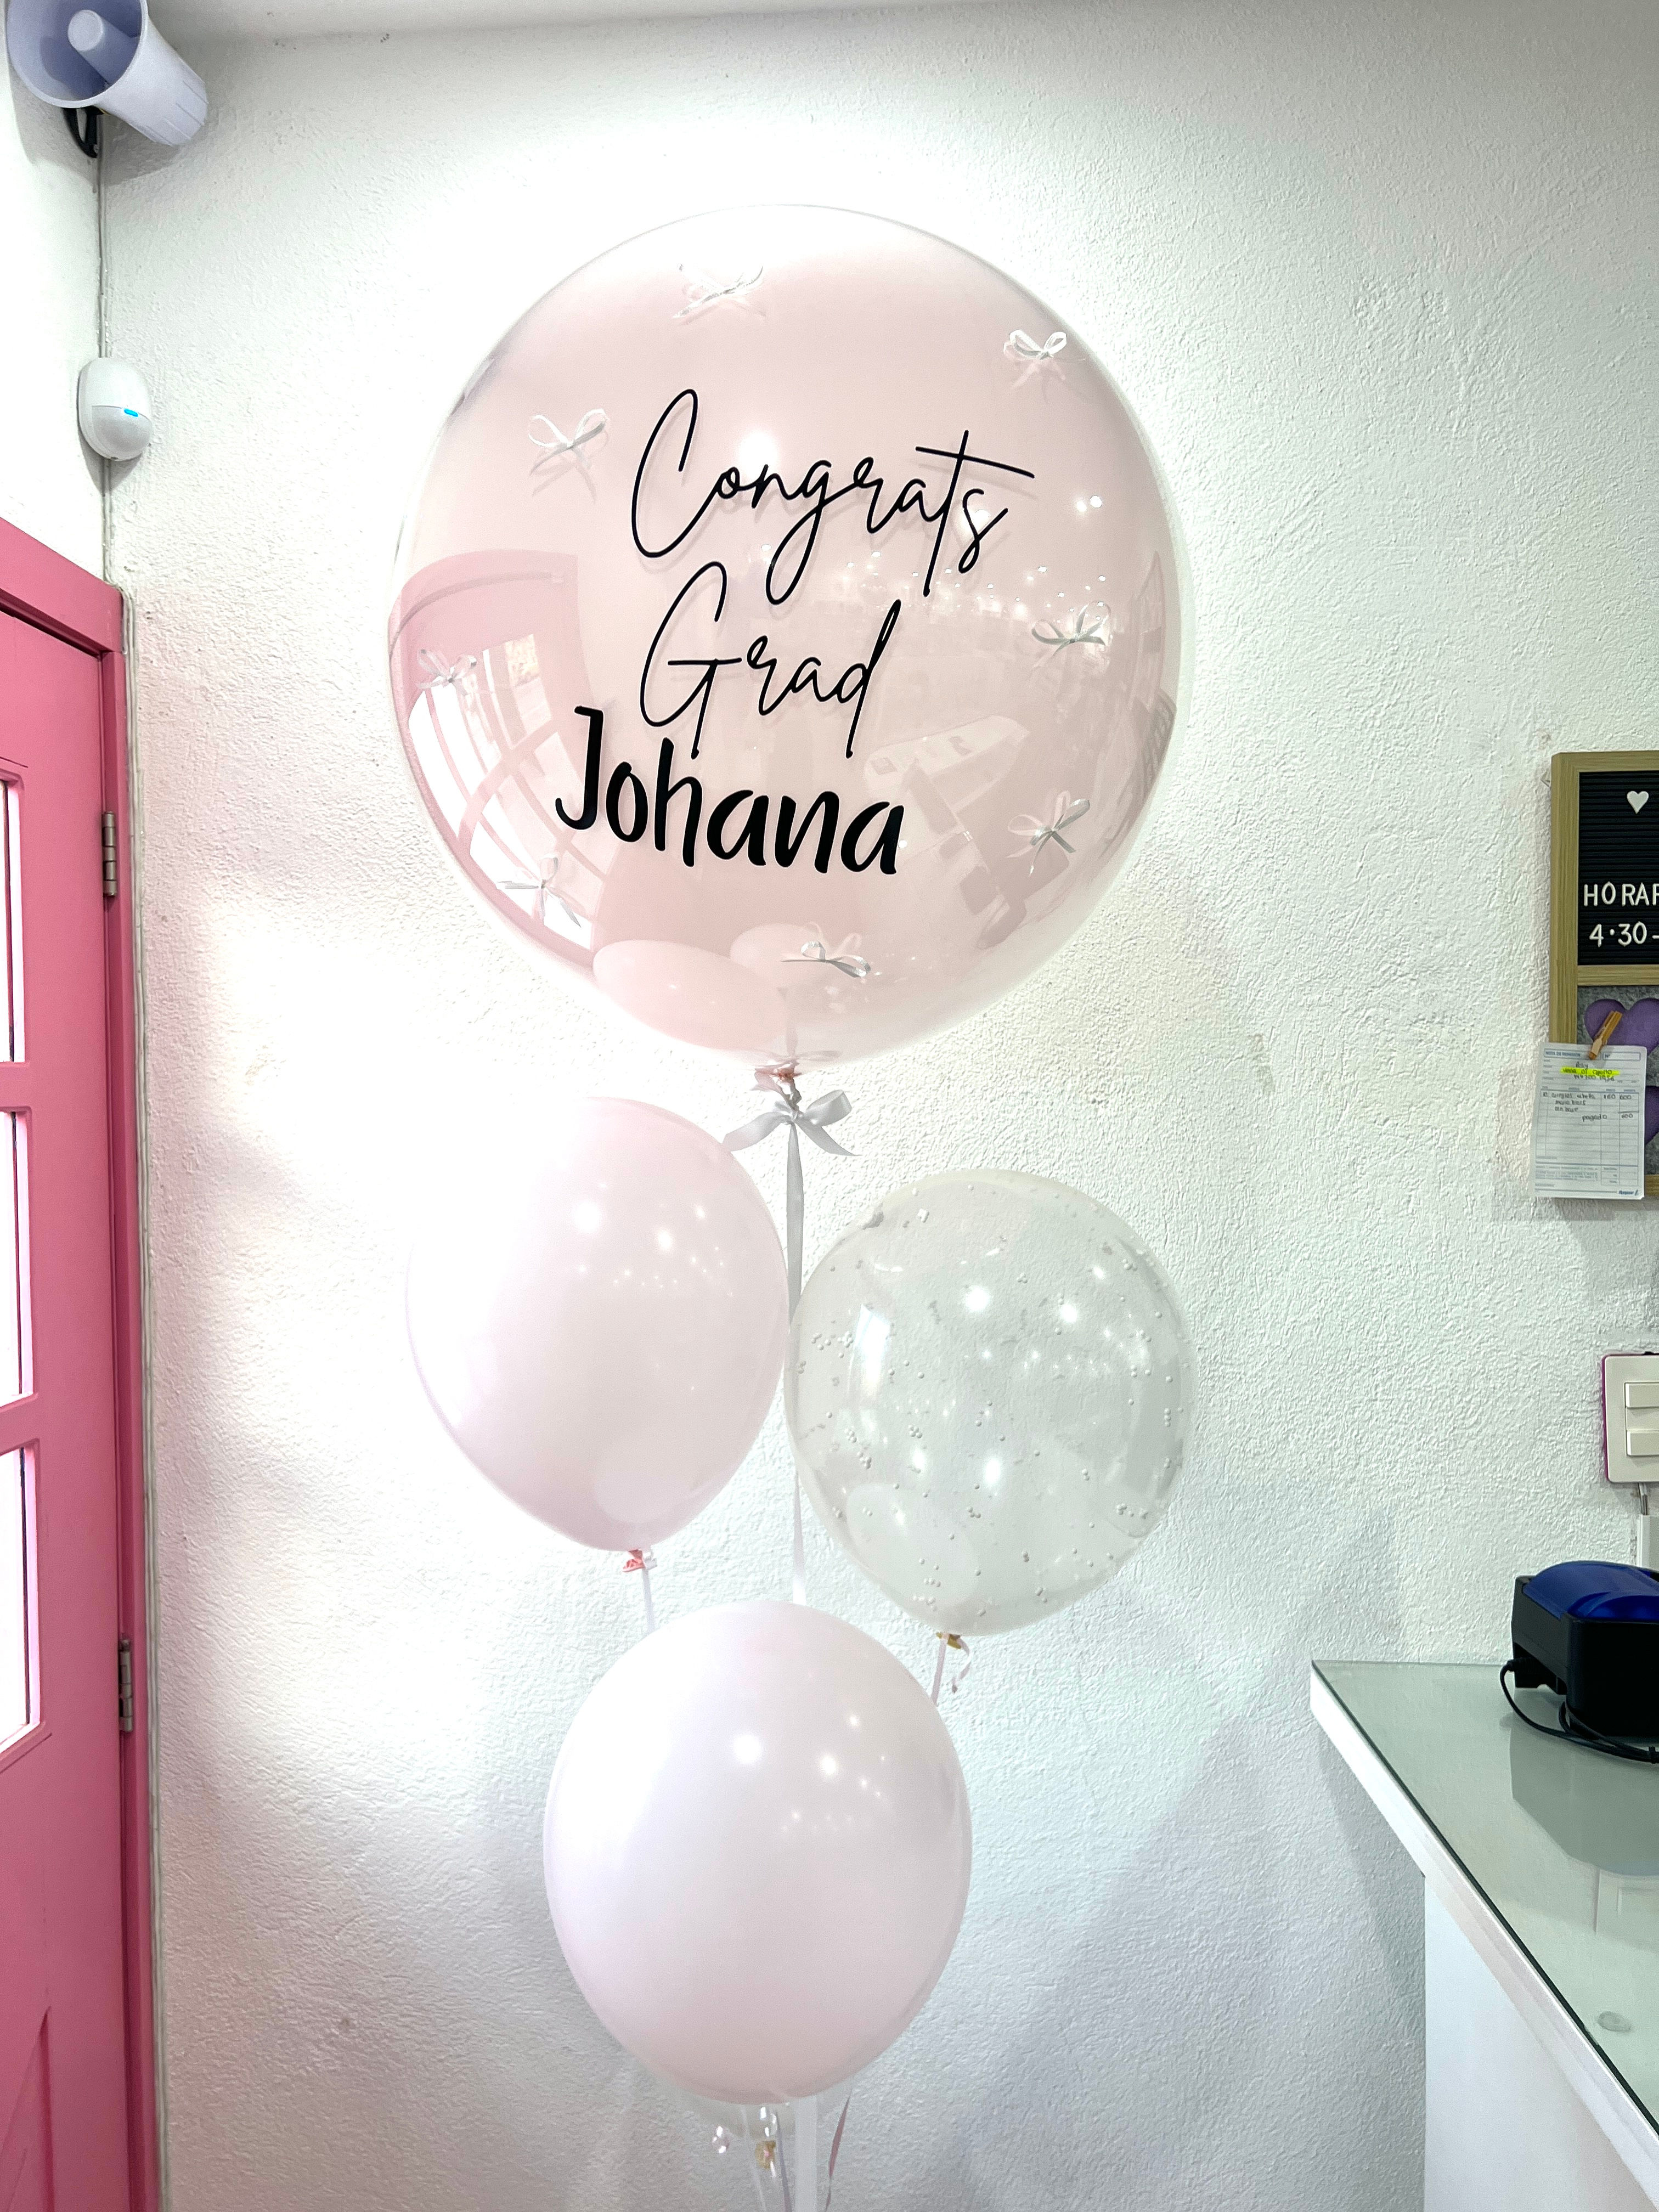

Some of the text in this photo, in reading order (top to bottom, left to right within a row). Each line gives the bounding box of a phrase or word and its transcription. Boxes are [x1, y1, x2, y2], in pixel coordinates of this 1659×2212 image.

[631, 388, 1035, 605] Congrats
[640, 561, 902, 759] Grad
[555, 706, 904, 875] Johana
